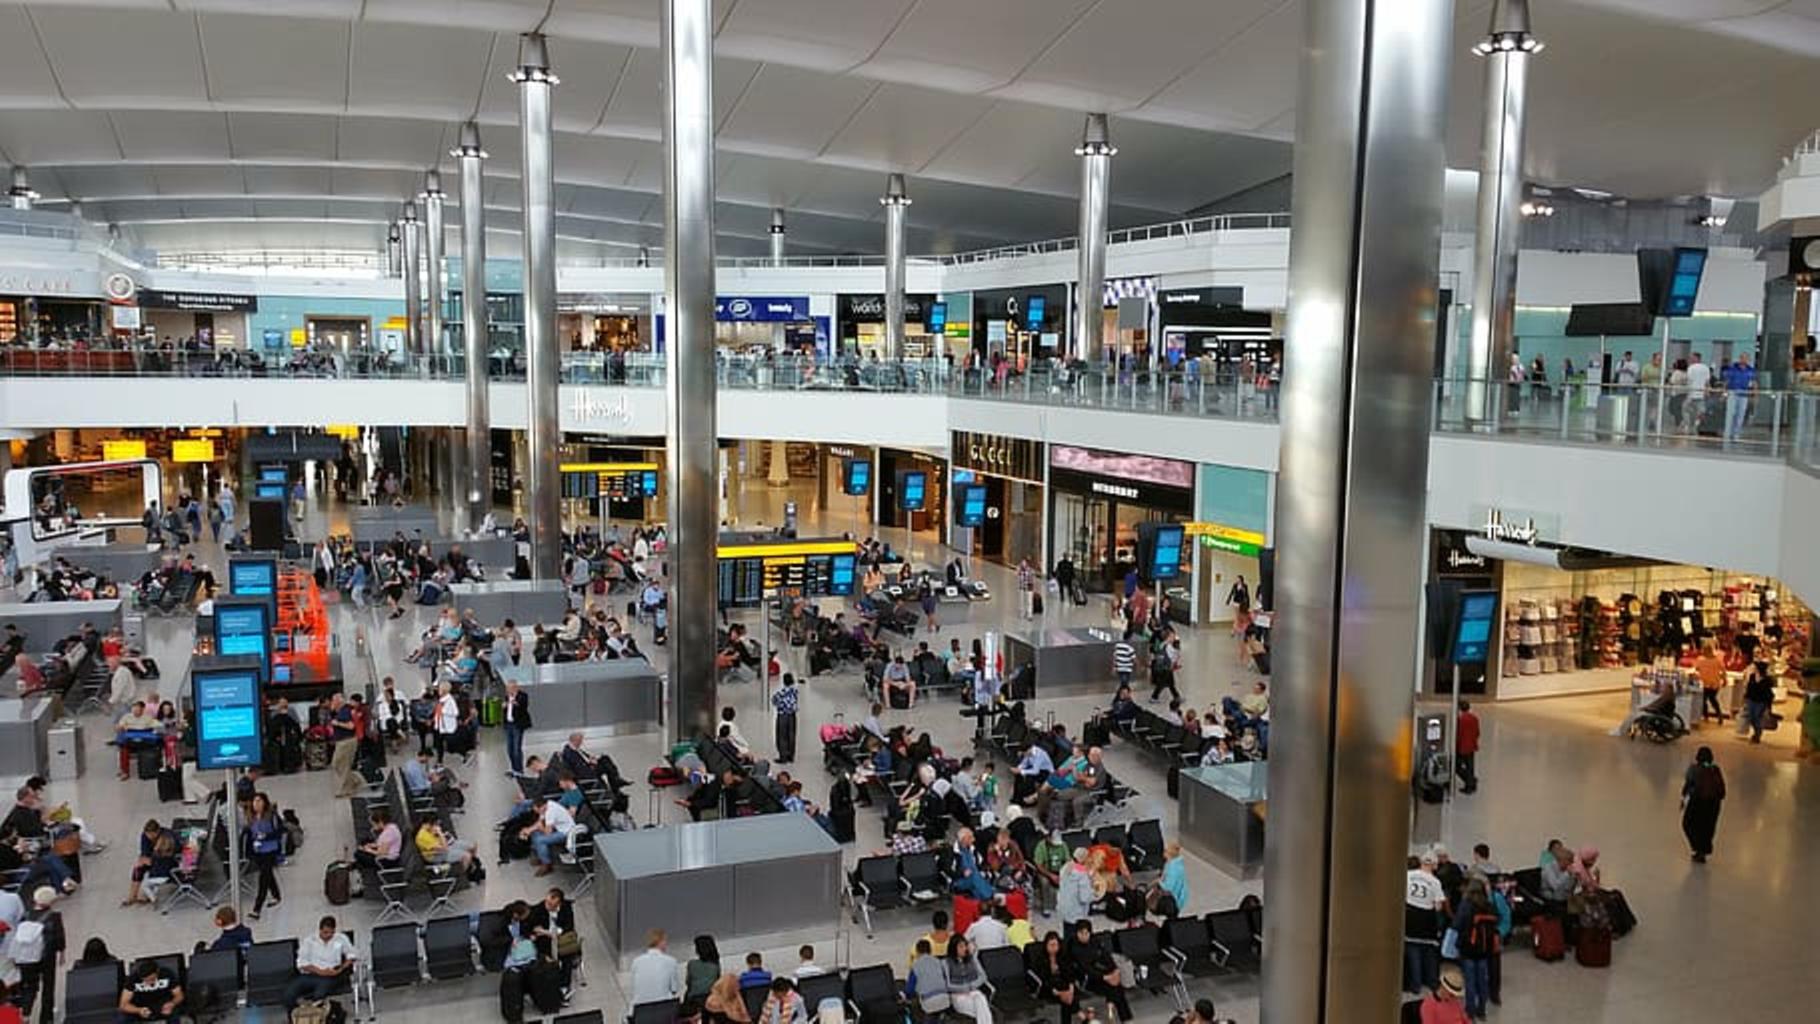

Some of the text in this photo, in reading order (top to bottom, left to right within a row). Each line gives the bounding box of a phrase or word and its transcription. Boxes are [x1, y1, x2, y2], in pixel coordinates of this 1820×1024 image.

[970, 445, 1011, 466] GUCCI
[1483, 508, 1537, 546] Harrods
[1447, 549, 1486, 567] Harrods
[1410, 883, 1427, 898] 23
